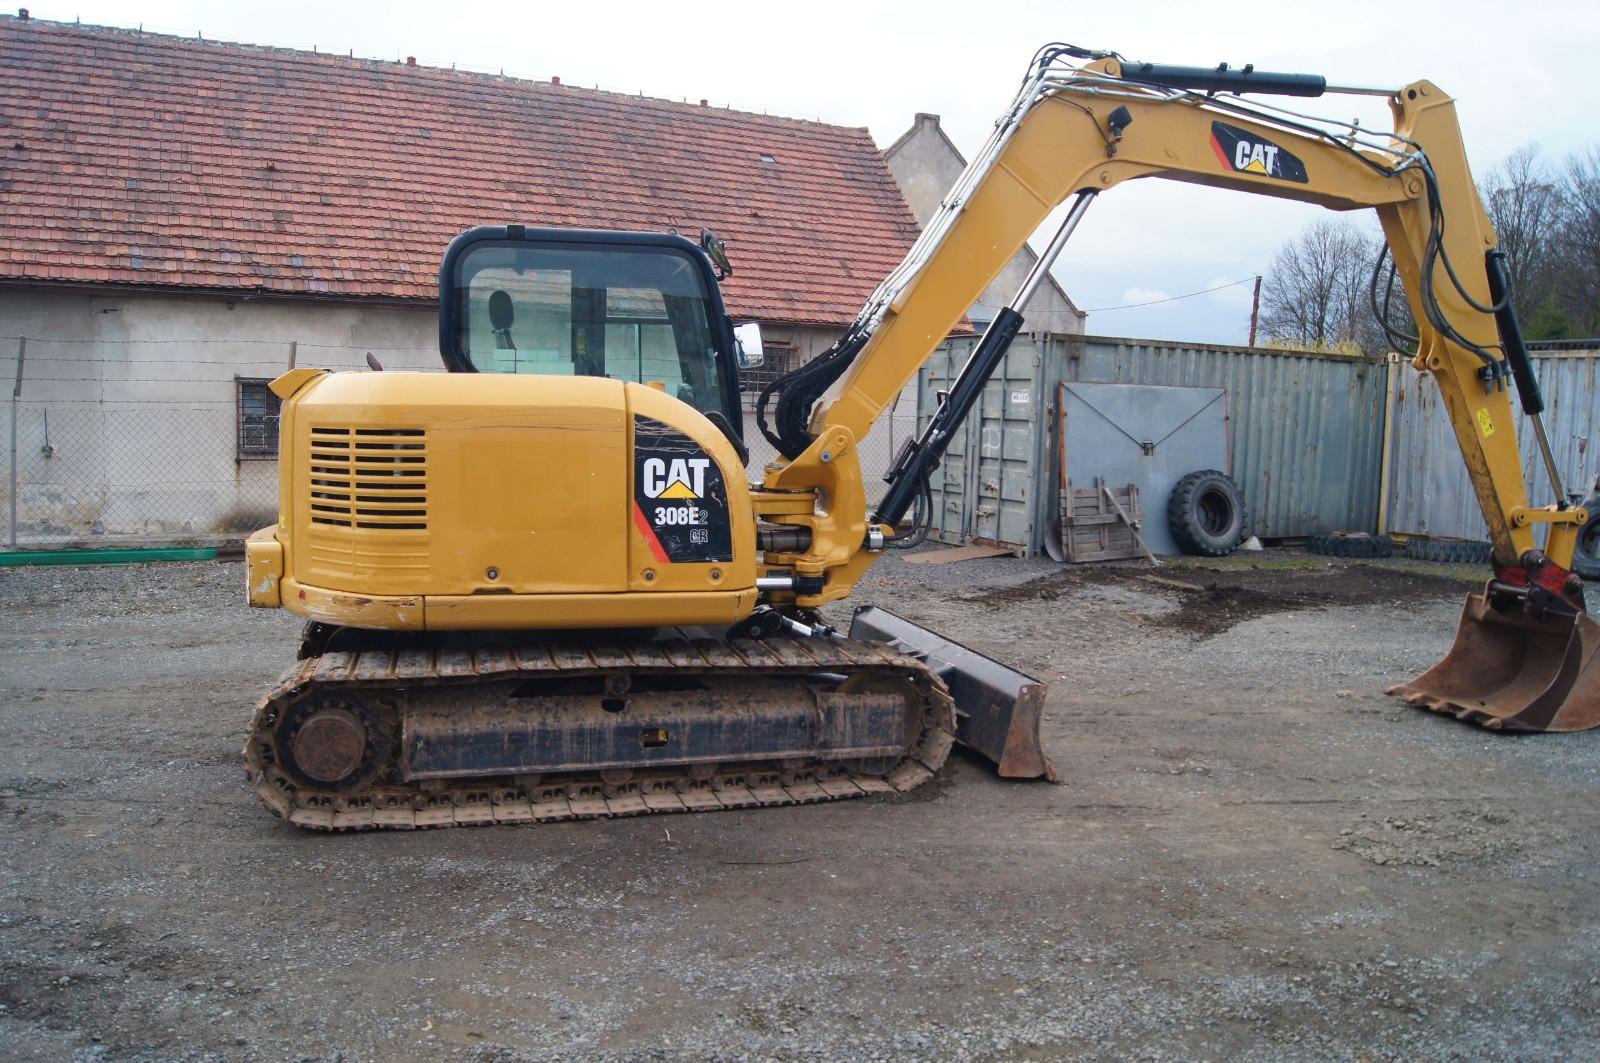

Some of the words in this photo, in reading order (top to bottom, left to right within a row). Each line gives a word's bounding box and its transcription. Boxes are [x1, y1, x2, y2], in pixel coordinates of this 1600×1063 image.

[1235, 140, 1278, 175] CAT
[643, 457, 710, 499] CAT
[654, 506, 708, 525] 308E2
